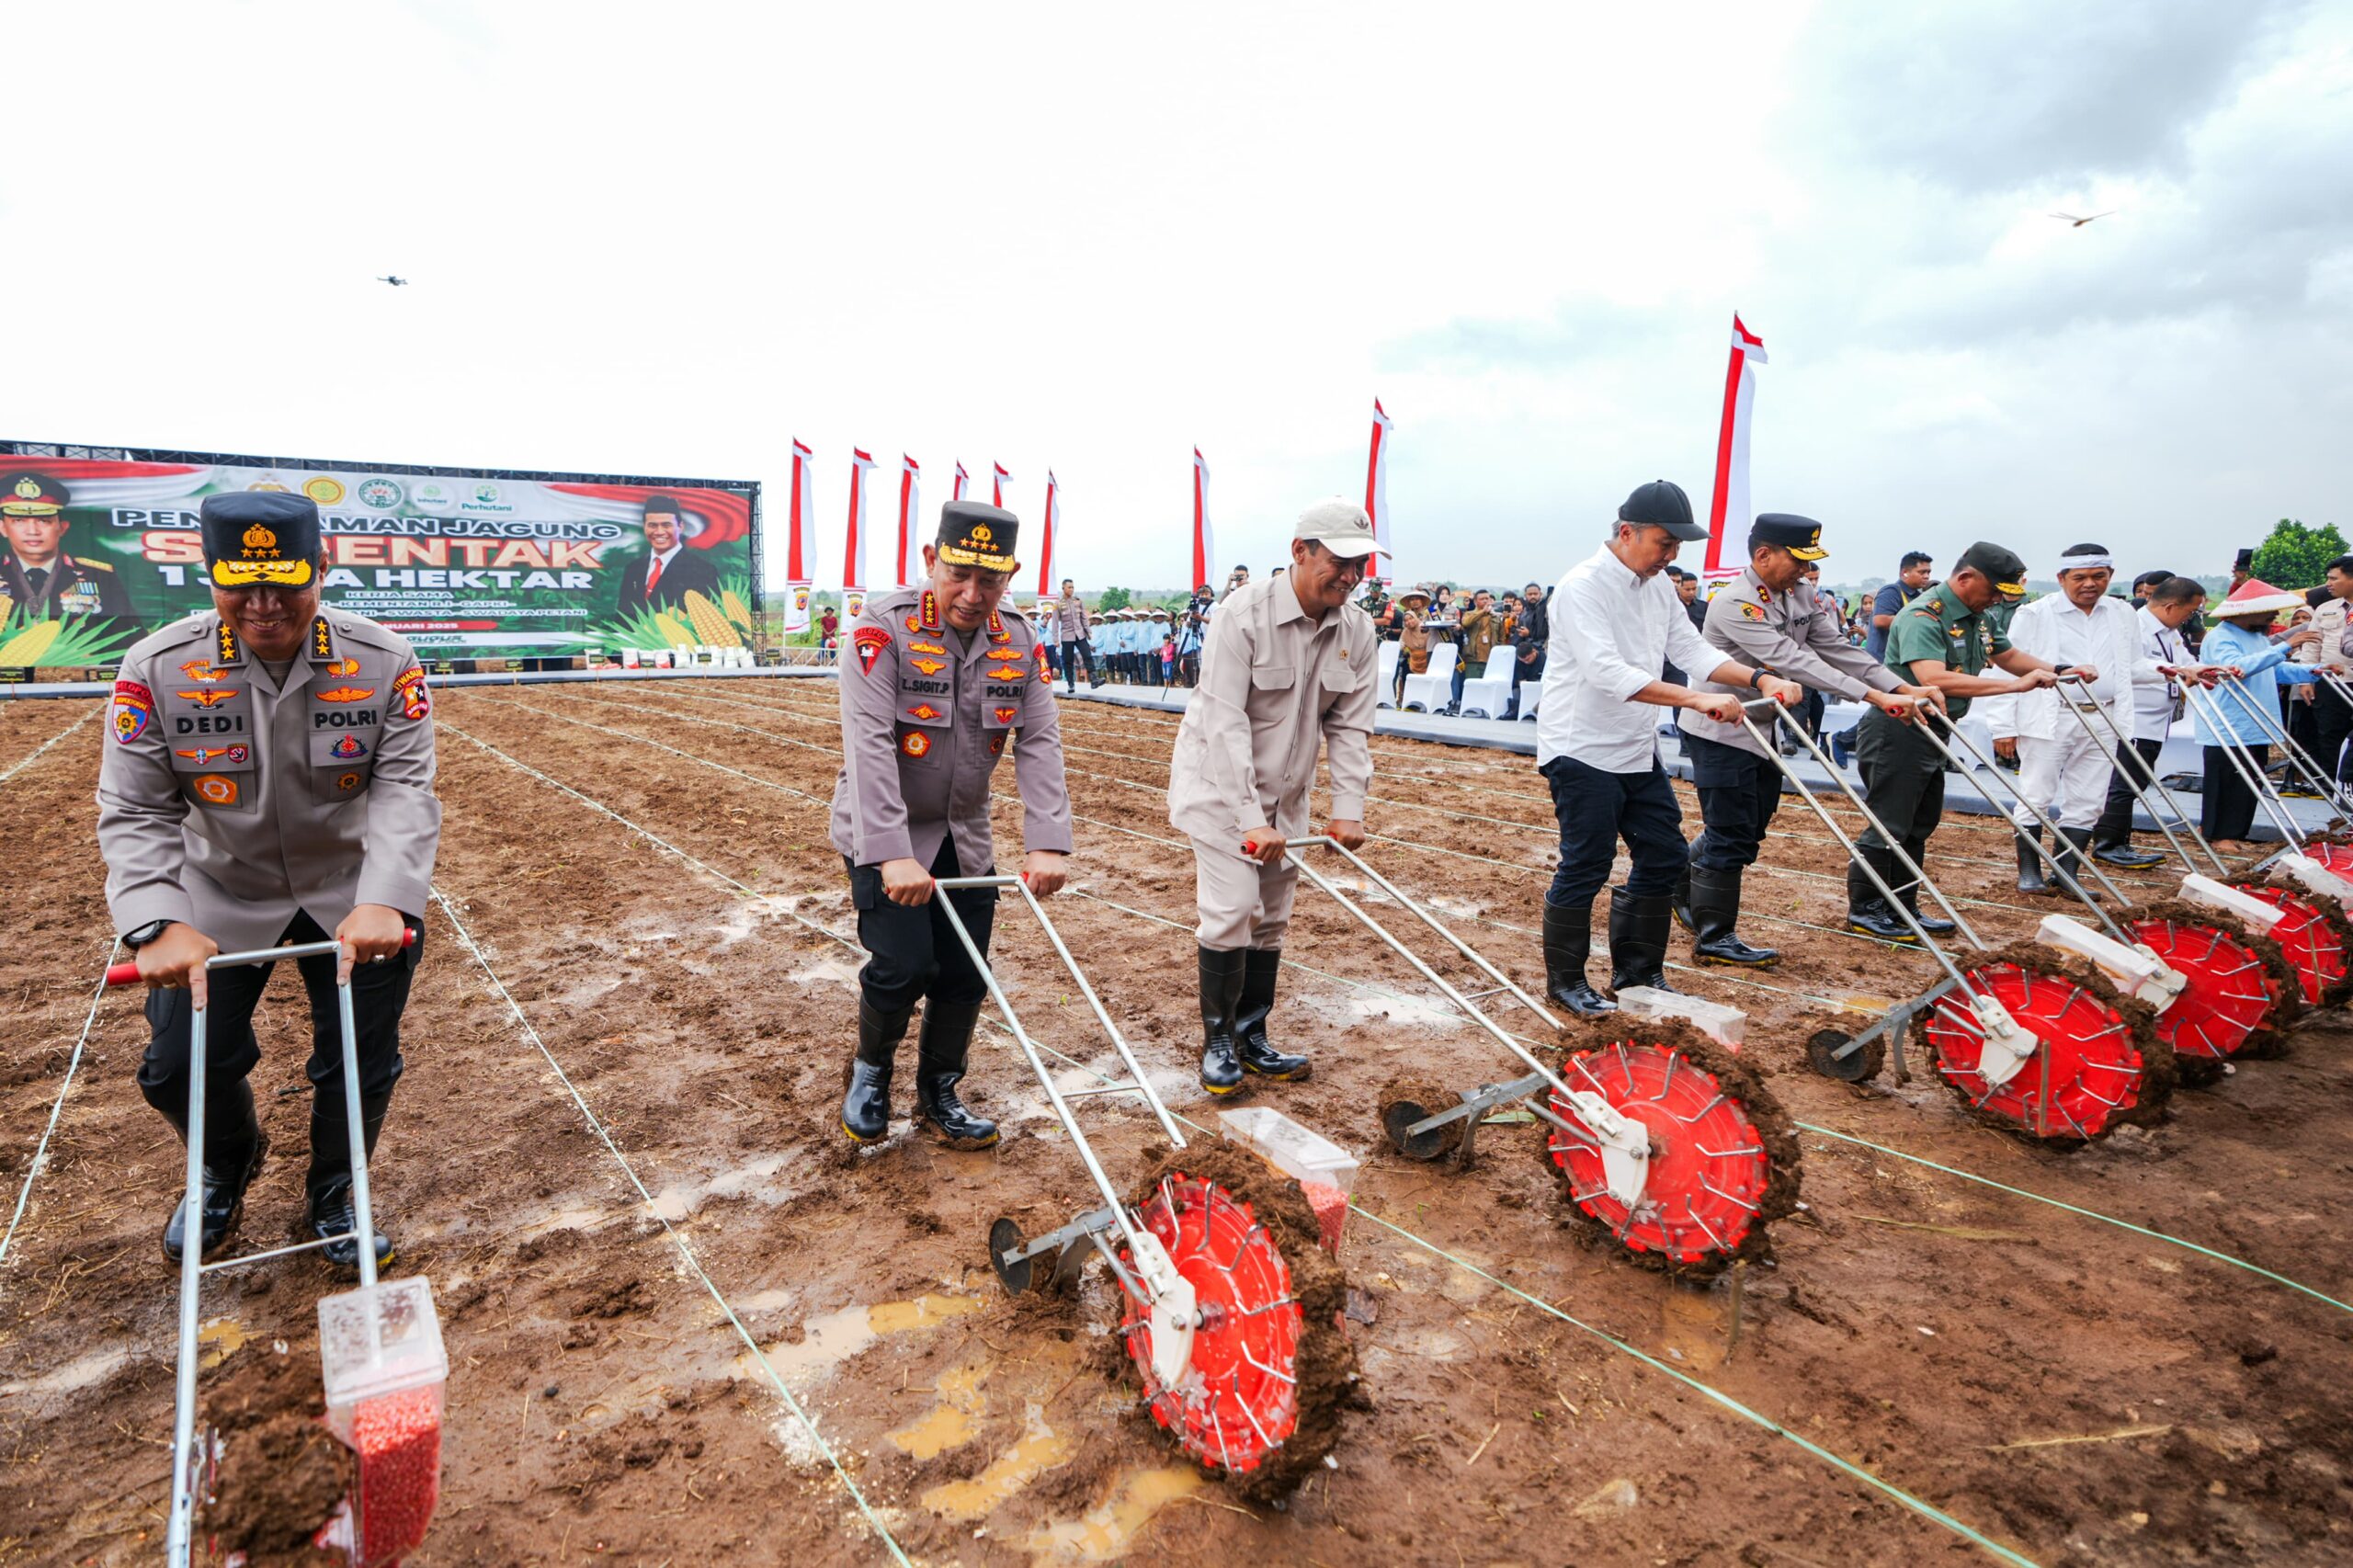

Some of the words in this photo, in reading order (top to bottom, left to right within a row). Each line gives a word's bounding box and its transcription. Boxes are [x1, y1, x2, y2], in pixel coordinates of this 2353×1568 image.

[461, 503, 513, 512] Perhutani
[443, 519, 621, 540] JAGUNG
[375, 569, 593, 589] HEKTAR
[986, 686, 1023, 698] POLRI
[176, 716, 243, 733] DEDI
[314, 710, 377, 728] POLRI
